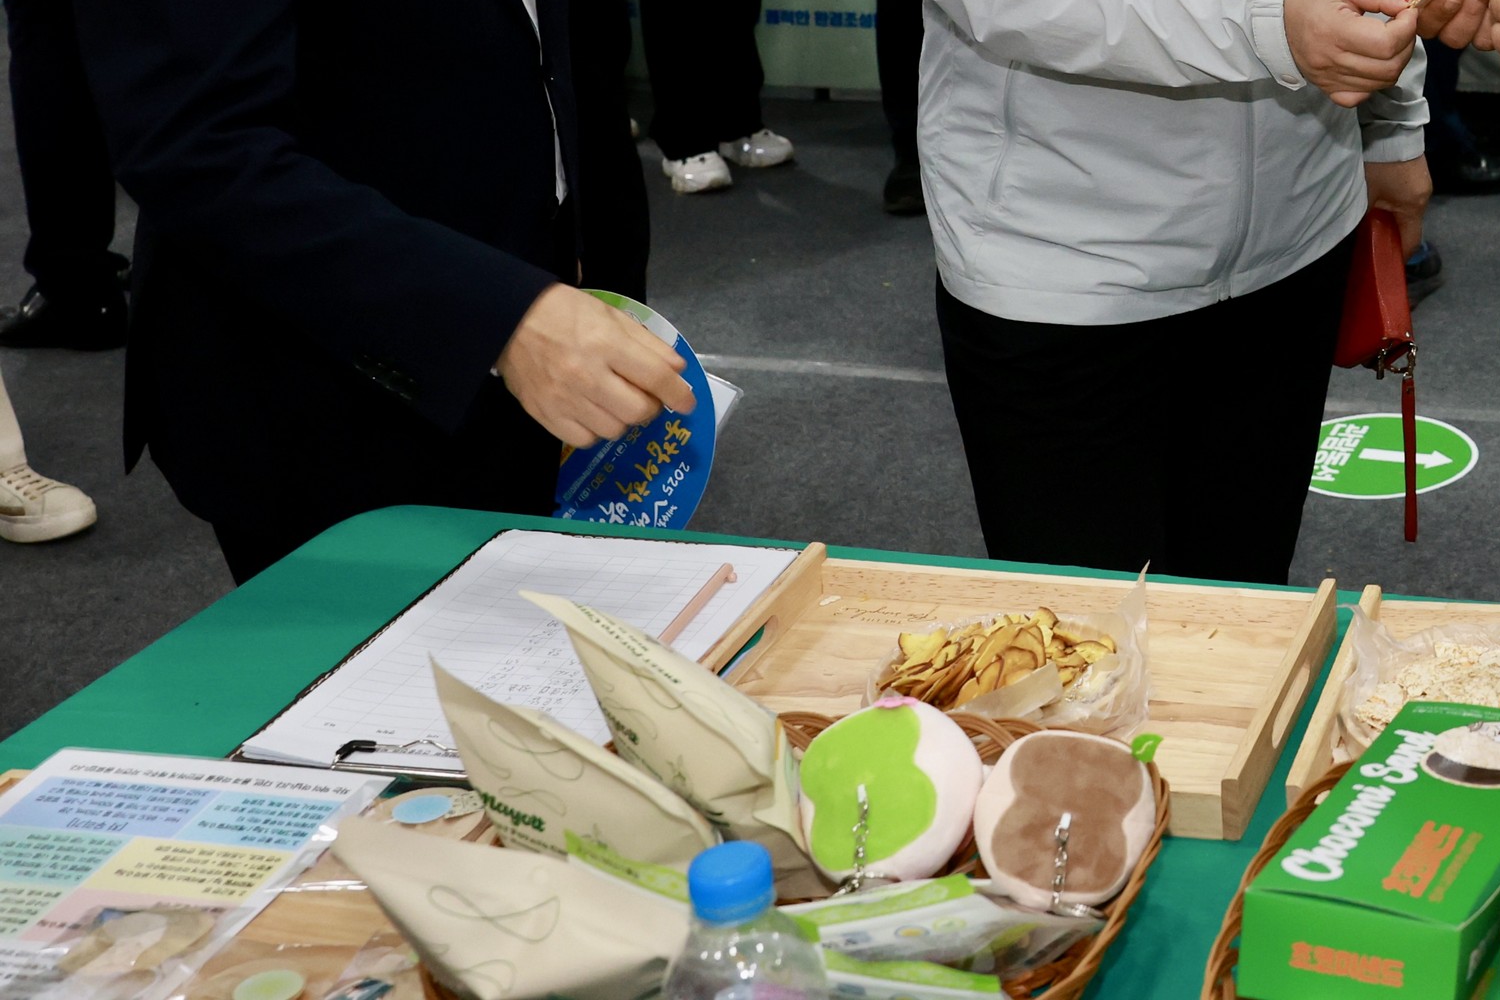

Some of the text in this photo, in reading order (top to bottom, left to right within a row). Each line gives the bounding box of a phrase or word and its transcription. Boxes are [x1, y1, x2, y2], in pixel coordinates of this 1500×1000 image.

[615, 420, 692, 502] 통합의학
[662, 461, 690, 497] 2025
[1280, 728, 1438, 881] Chocomi Sand
